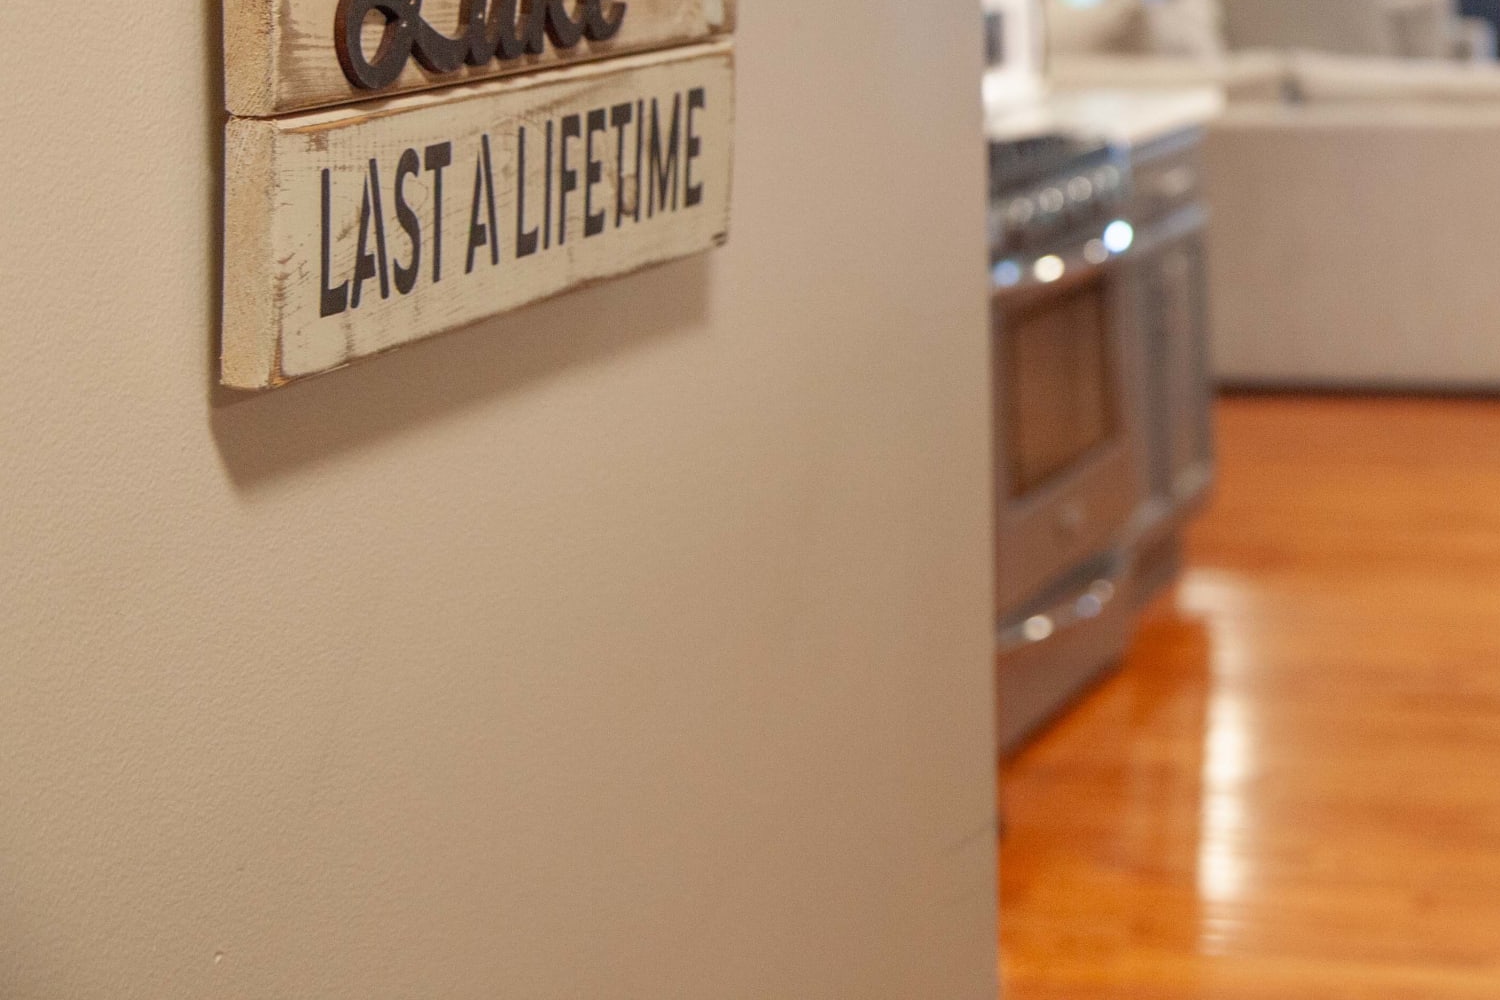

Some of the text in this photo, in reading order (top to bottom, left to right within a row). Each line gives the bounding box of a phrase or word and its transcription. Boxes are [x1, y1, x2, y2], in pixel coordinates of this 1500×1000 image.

[319, 87, 705, 318] LAST A LIFETIME
